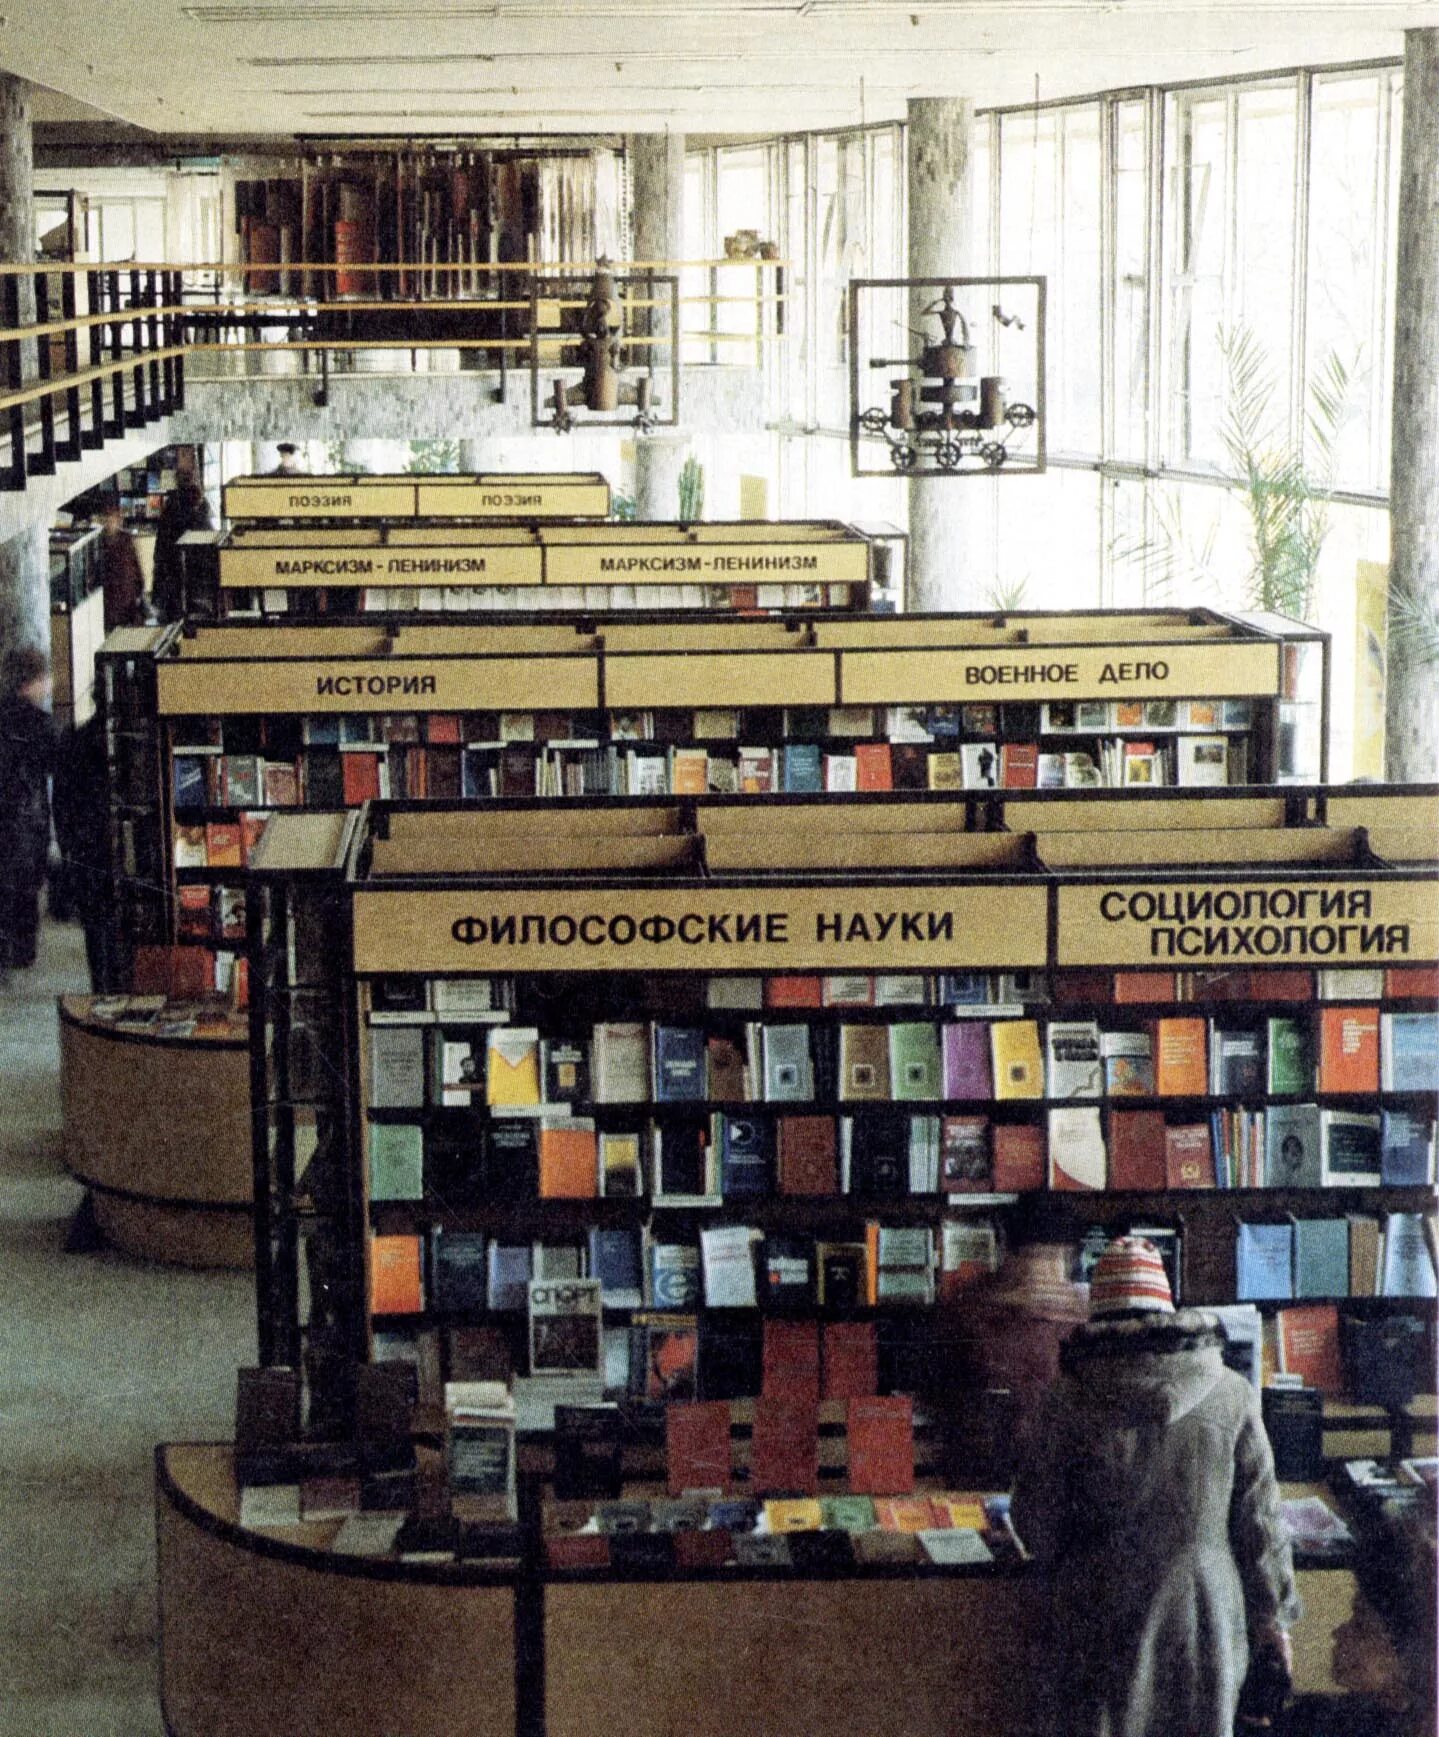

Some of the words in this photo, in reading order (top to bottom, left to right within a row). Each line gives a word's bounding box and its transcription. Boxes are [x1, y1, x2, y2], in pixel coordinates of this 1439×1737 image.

[288, 495, 352, 508] ПОЭЗИЯ
[481, 494, 543, 507] ПОЭЗИЯ
[317, 675, 438, 697] ИСТОРИЯ
[965, 664, 1078, 686] ВОЕННОЕ
[1098, 661, 1170, 685] ДЕЛО
[1100, 888, 1373, 923] СОЦИОЛОГИЯ
[451, 913, 789, 947] ФИЛОСОФСКИЕ
[816, 912, 954, 943] НАУКИ
[1150, 924, 1411, 957] ПСИХОЛОГИЯ
